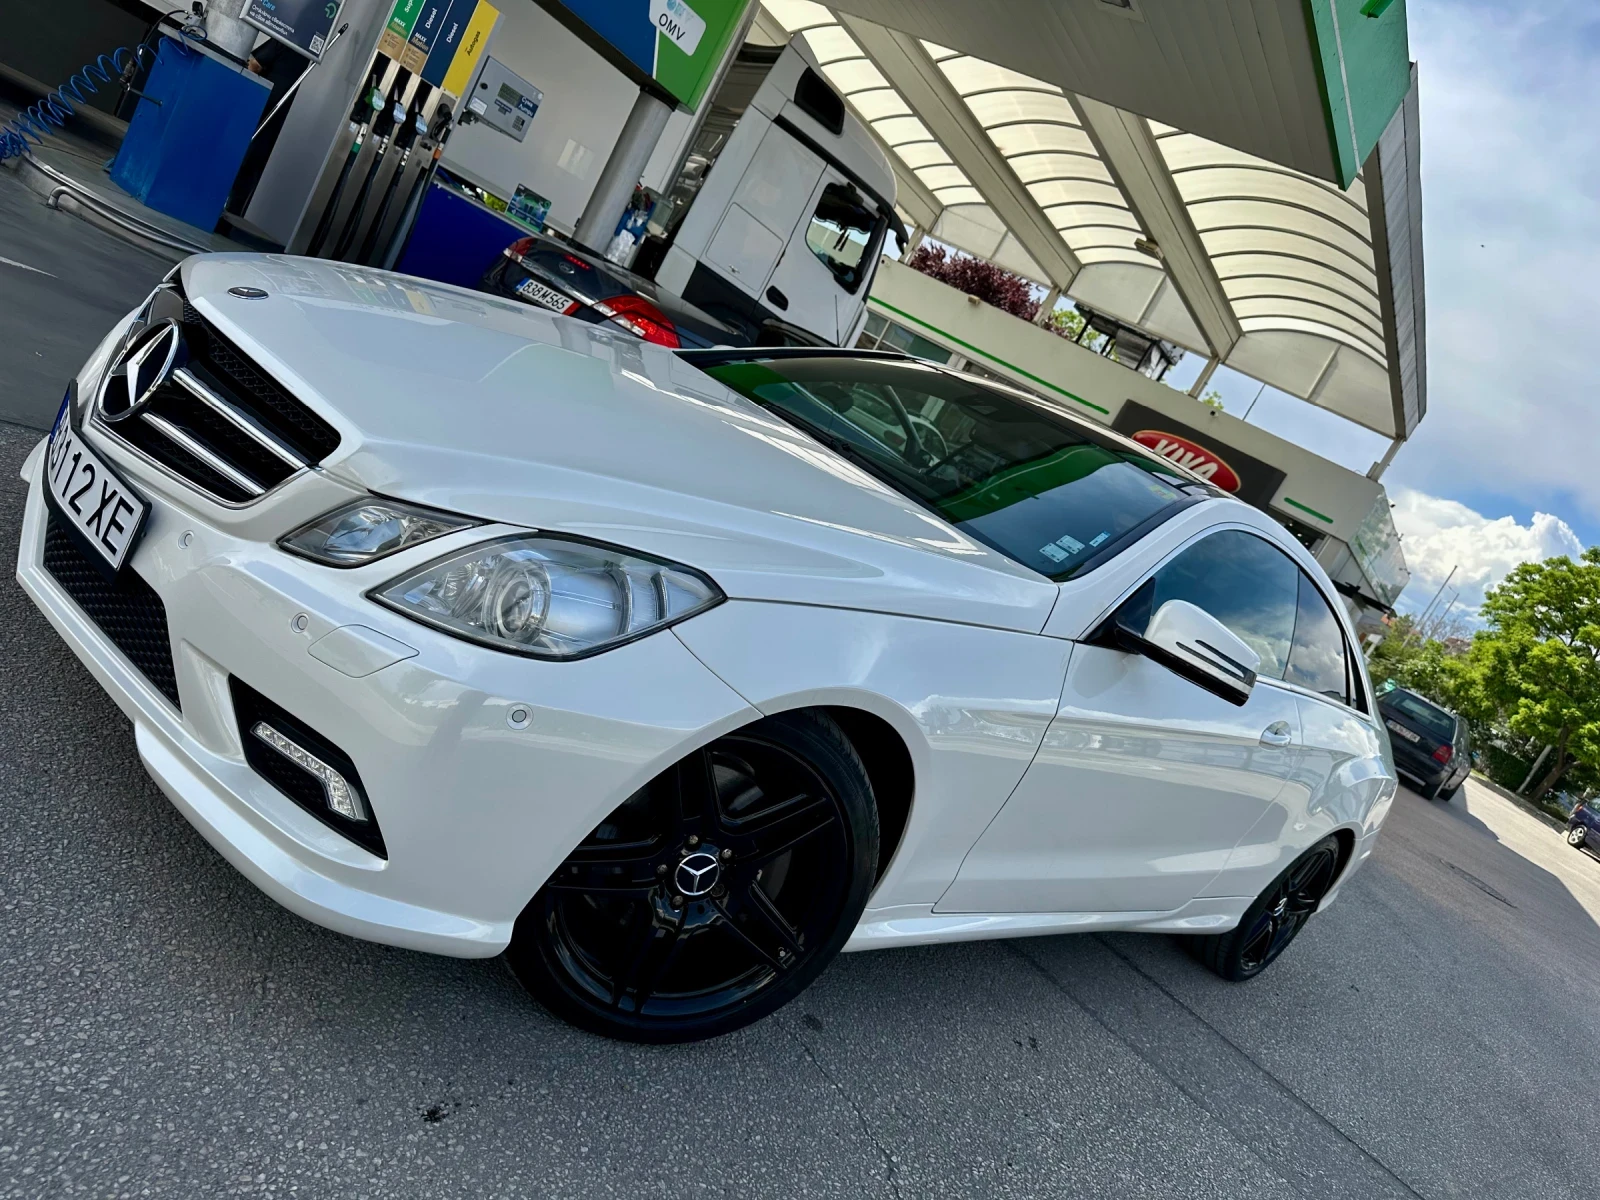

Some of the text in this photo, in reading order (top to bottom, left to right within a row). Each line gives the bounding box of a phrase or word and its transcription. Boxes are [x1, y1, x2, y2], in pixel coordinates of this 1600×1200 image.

[393, 17, 406, 28] MAXX
[425, 7, 438, 29] Diesel
[658, 13, 686, 41] OMV
[415, 32, 427, 43] MAXX
[446, 22, 459, 43] Diesel
[467, 30, 481, 56] Autogas
[1153, 438, 1218, 480] VIVA
